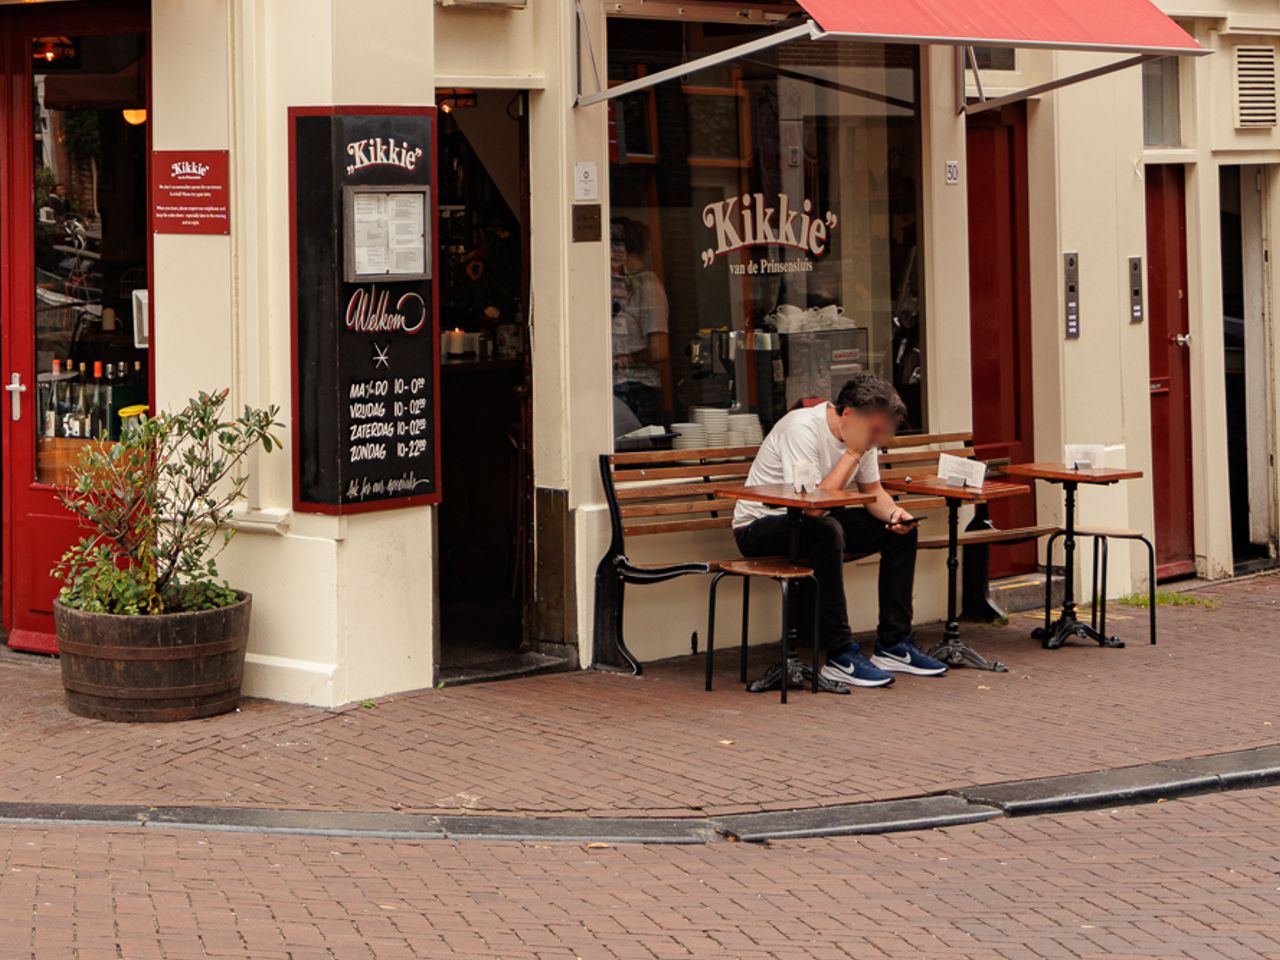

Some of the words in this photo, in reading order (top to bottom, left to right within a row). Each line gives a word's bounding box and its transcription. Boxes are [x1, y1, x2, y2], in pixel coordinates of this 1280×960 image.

[946, 164, 959, 181] 30
[729, 261, 745, 275] van
[747, 259, 758, 275] de
[760, 257, 814, 274] Prinsensluis
[350, 422, 394, 441] ZATERDAG
[350, 443, 386, 462] ZONDAG
